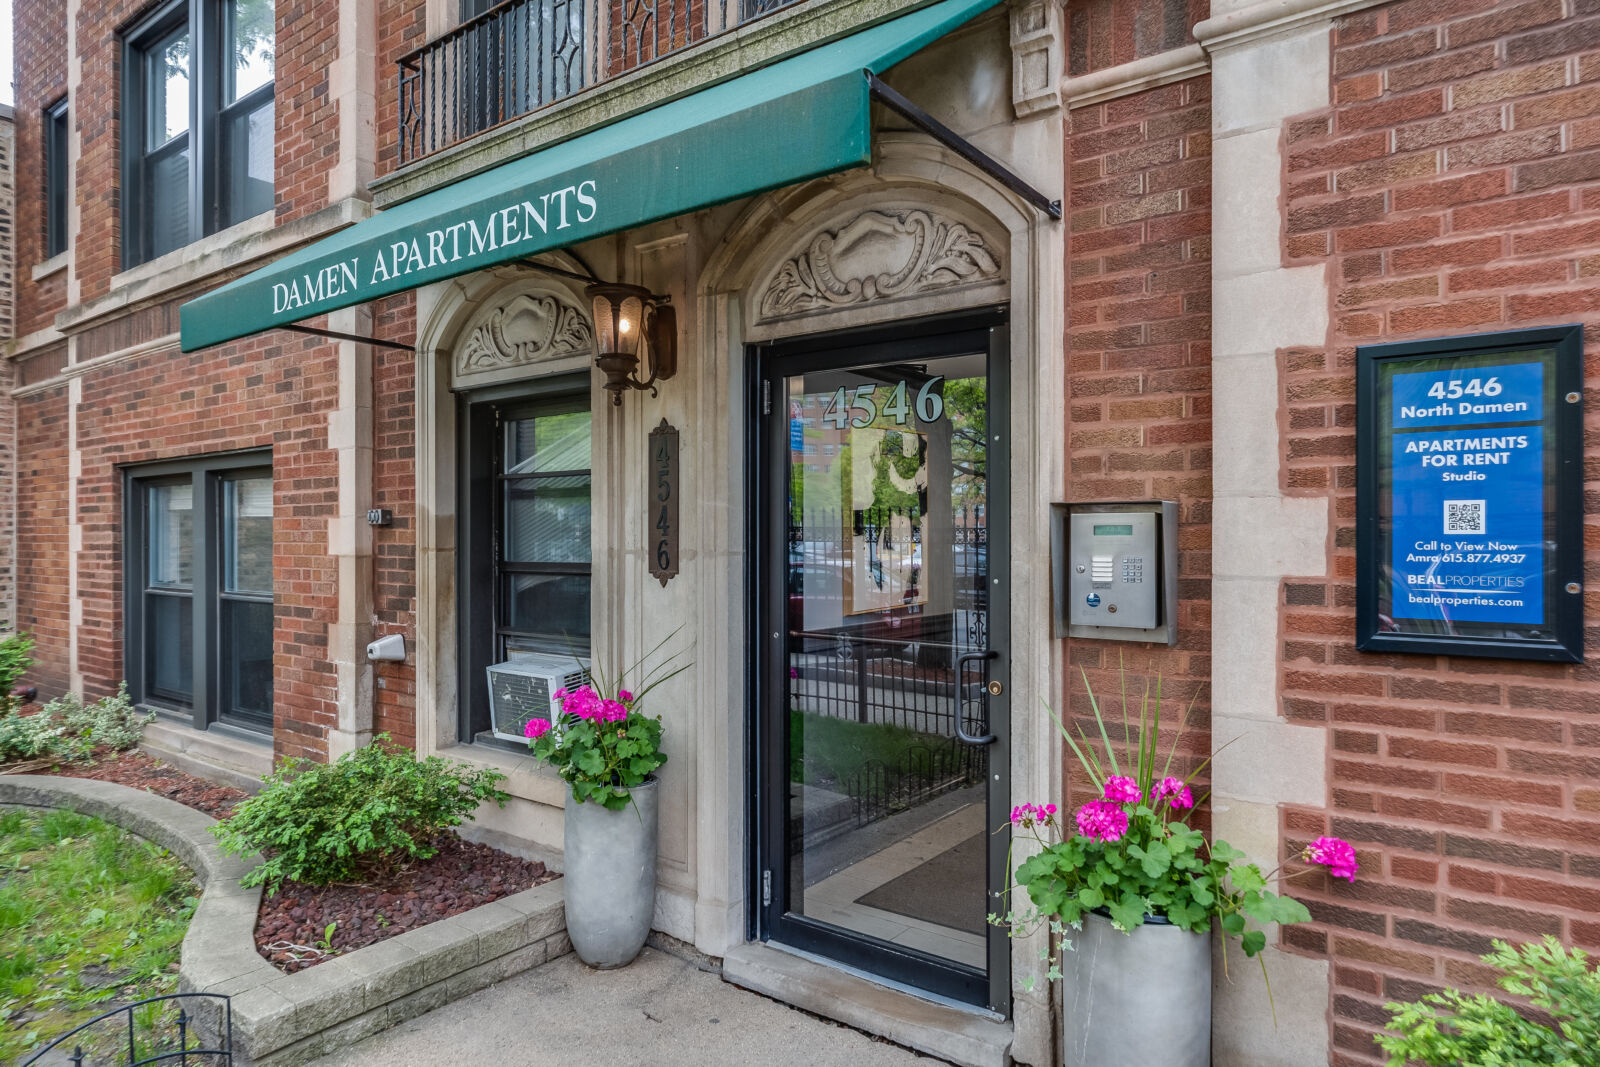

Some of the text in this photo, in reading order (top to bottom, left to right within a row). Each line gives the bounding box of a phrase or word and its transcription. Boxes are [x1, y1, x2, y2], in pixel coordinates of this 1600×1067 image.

[272, 180, 597, 314] DAMEN APARTMENTS
[1427, 376, 1502, 400] 4546
[823, 375, 945, 430] 4546
[1401, 402, 1527, 418] North Damen
[1405, 436, 1528, 453] APARTMENTS
[1422, 451, 1511, 468] FOR RENT
[1442, 471, 1486, 482] Studio
[655, 436, 671, 571] 4546
[1415, 540, 1518, 552] Call to View Now
[1406, 553, 1526, 564] Amra 615.877.4937
[1408, 593, 1523, 607] bealproperties.com
